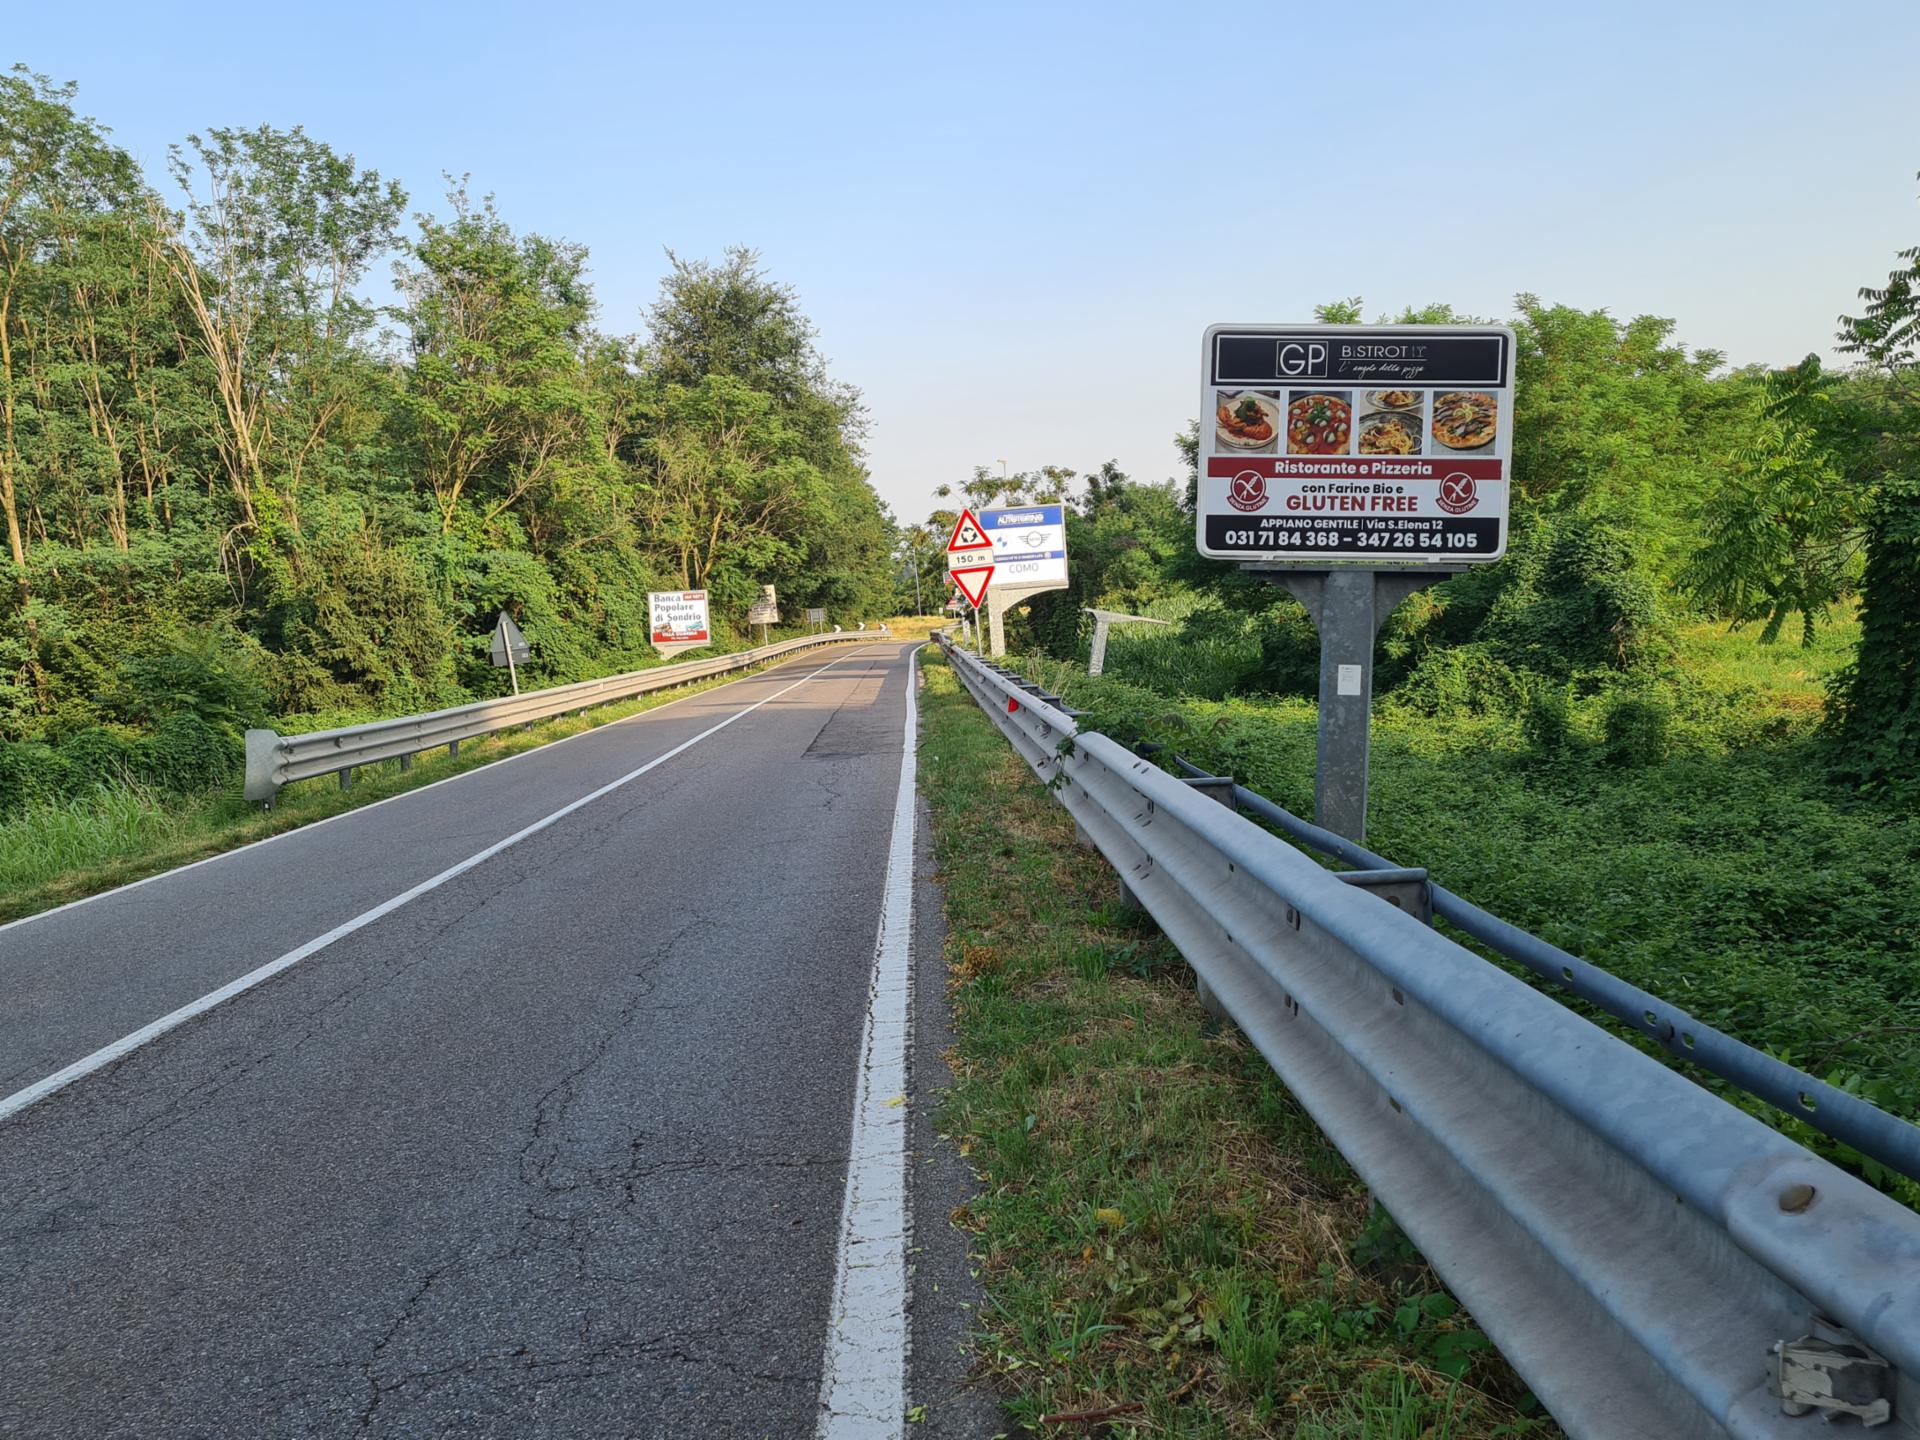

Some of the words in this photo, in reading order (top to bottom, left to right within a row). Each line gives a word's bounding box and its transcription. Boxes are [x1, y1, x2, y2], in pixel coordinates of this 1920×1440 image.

[1280, 344, 1326, 375] GP
[1275, 460, 1356, 474] Ristorante
[1360, 464, 1369, 474] e
[1372, 461, 1432, 476] Pizzeria
[1301, 484, 1326, 494] con
[1328, 482, 1370, 494] Farine
[1372, 482, 1394, 494] Bio
[1396, 486, 1404, 494] e
[1286, 495, 1366, 512] GLUTEN
[1370, 496, 1418, 512] FREE
[1260, 519, 1312, 529] APPIANO
[1314, 519, 1359, 529] GENTILE
[1366, 519, 1387, 529] Via
[1388, 520, 1430, 530] S.Elena
[1432, 520, 1443, 530] 12
[1278, 531, 1302, 546] 84
[1305, 532, 1339, 547] 368
[1357, 532, 1390, 547] 347
[1393, 532, 1415, 548] 26
[1419, 533, 1443, 548] 54
[1446, 533, 1478, 548] 105
[956, 555, 973, 564] 150
[1009, 562, 1039, 573] COMO
[654, 594, 681, 602] Banca
[654, 603, 694, 612] Popolare
[655, 614, 663, 622] di
[667, 612, 701, 622] Sondrio
